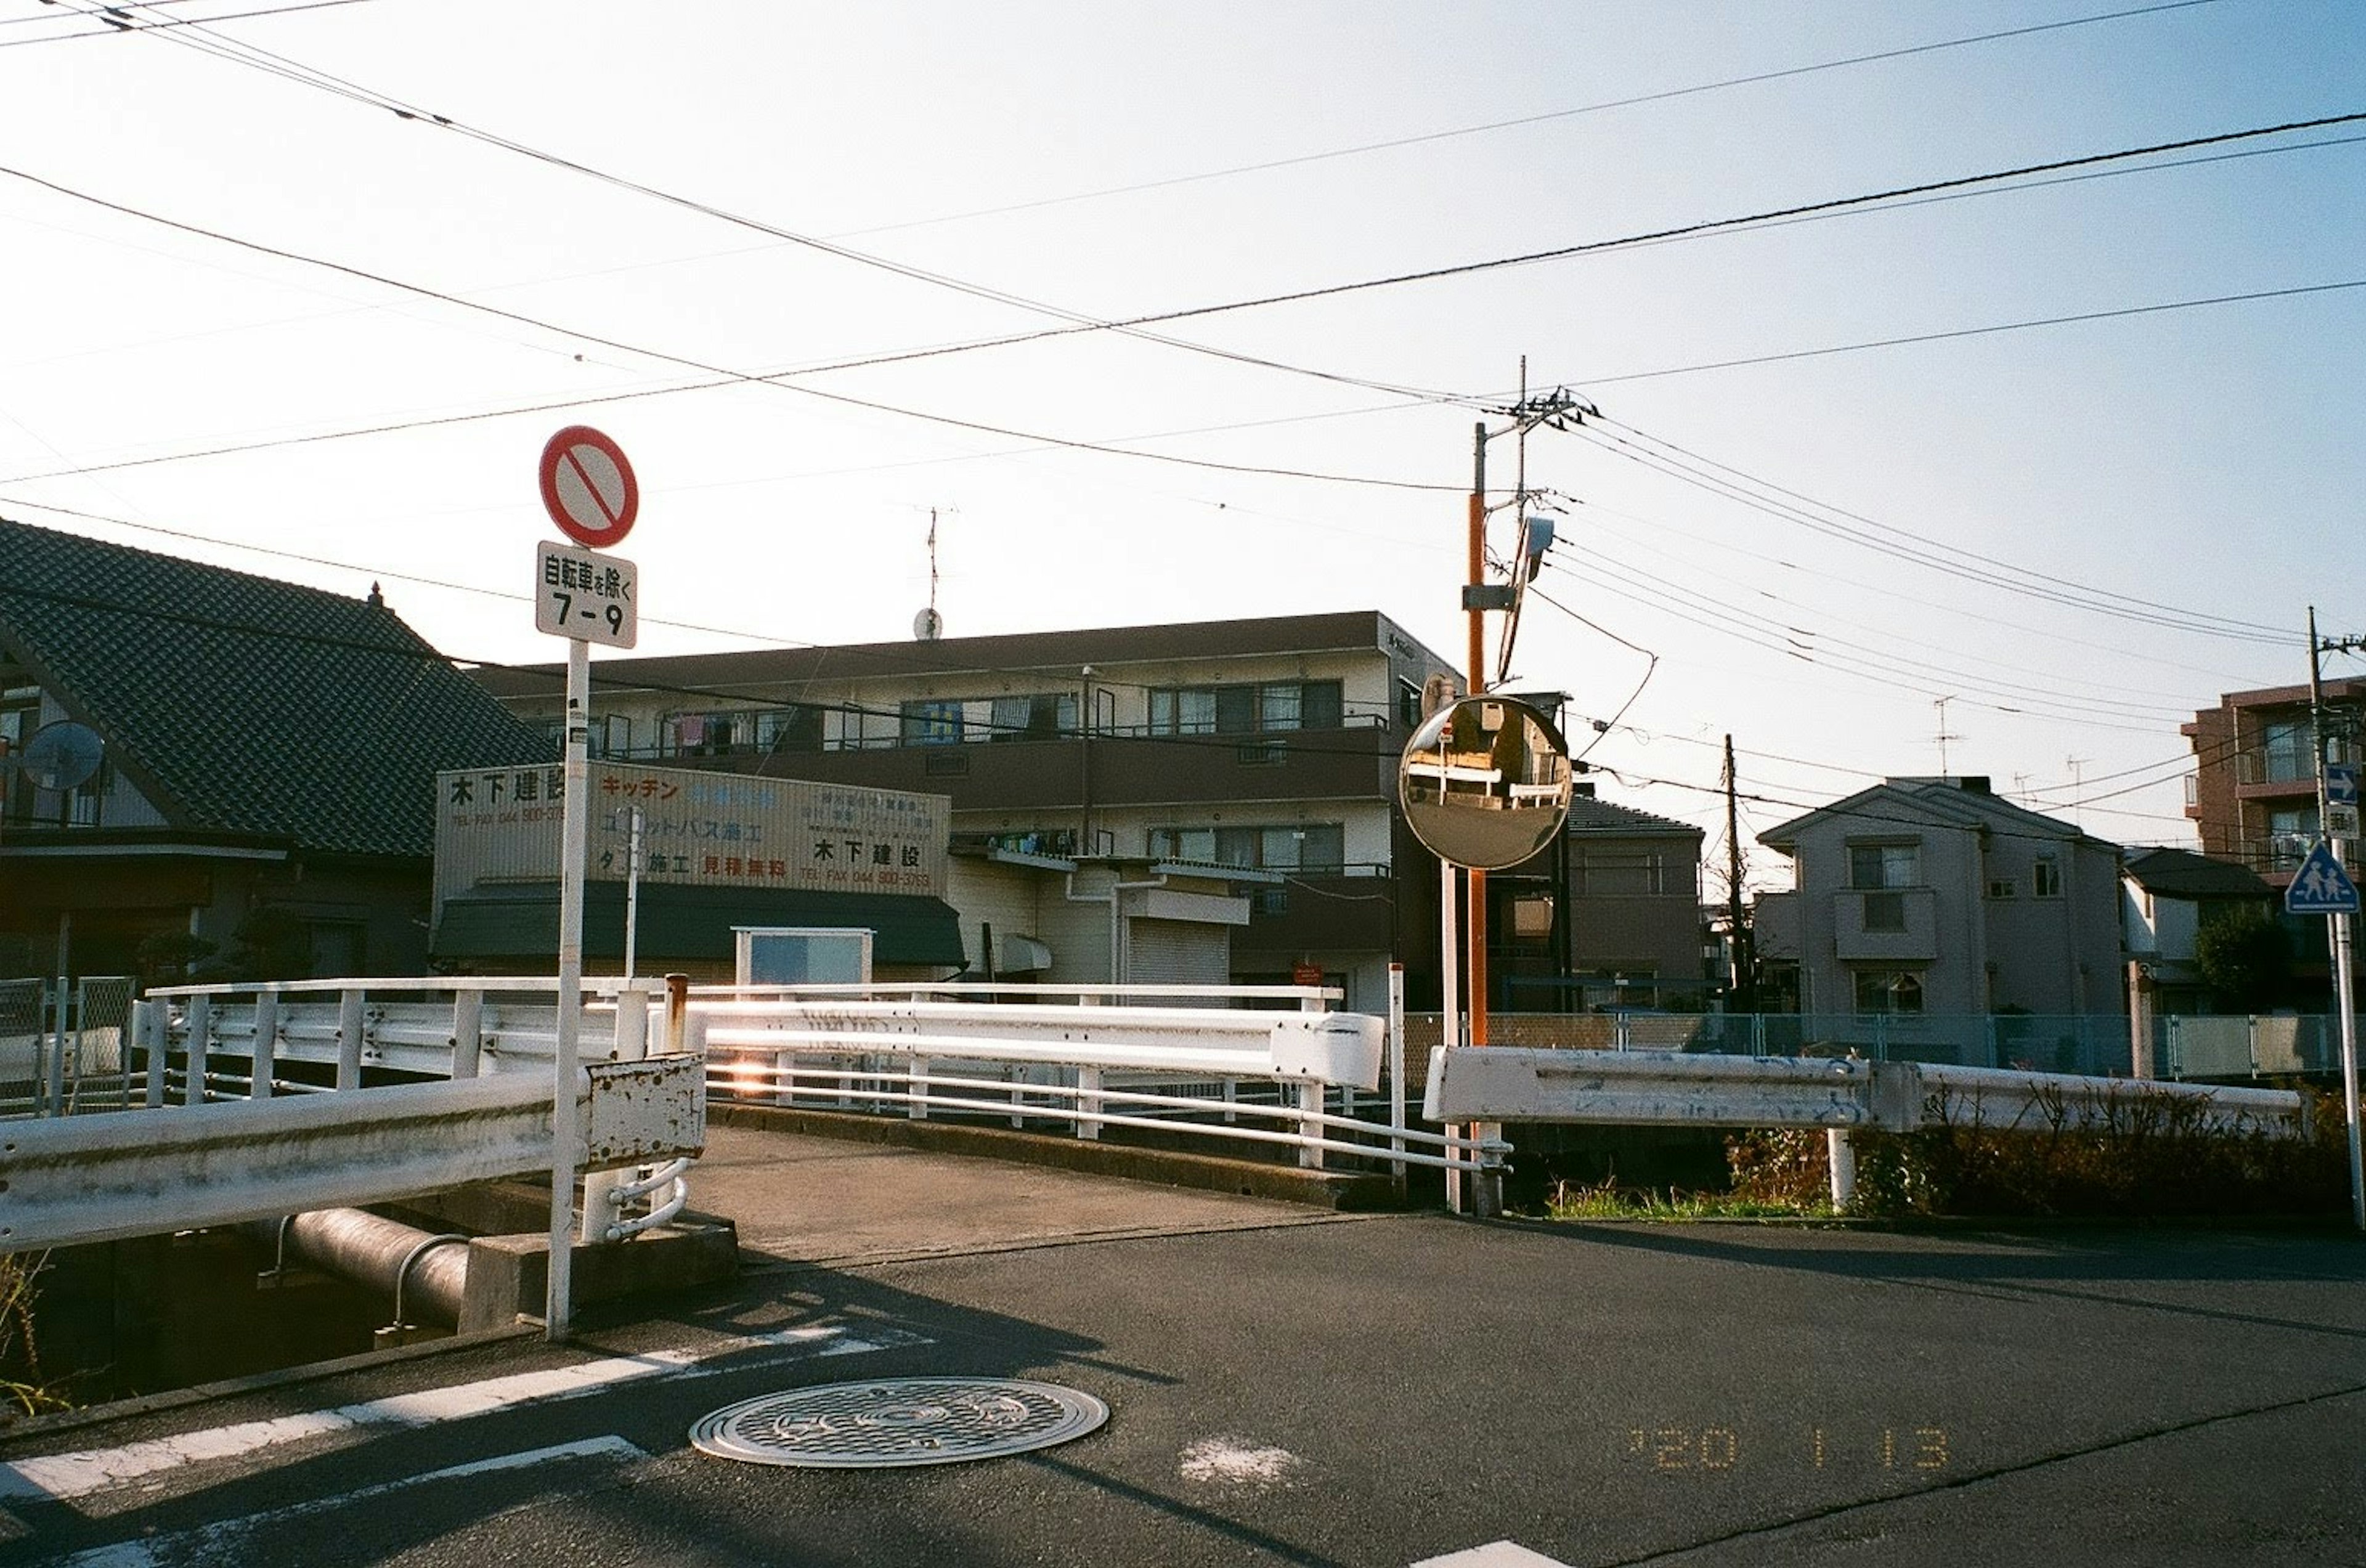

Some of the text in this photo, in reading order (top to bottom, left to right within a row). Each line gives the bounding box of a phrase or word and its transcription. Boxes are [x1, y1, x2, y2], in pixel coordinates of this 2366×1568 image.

[545, 554, 632, 601] 自転車を除く
[553, 593, 623, 636] 7-9
[603, 776, 678, 799] キッチン
[603, 813, 762, 843] ユットバス施工
[600, 850, 787, 878] タ施工 見積無料
[814, 839, 920, 867] 木下建設
